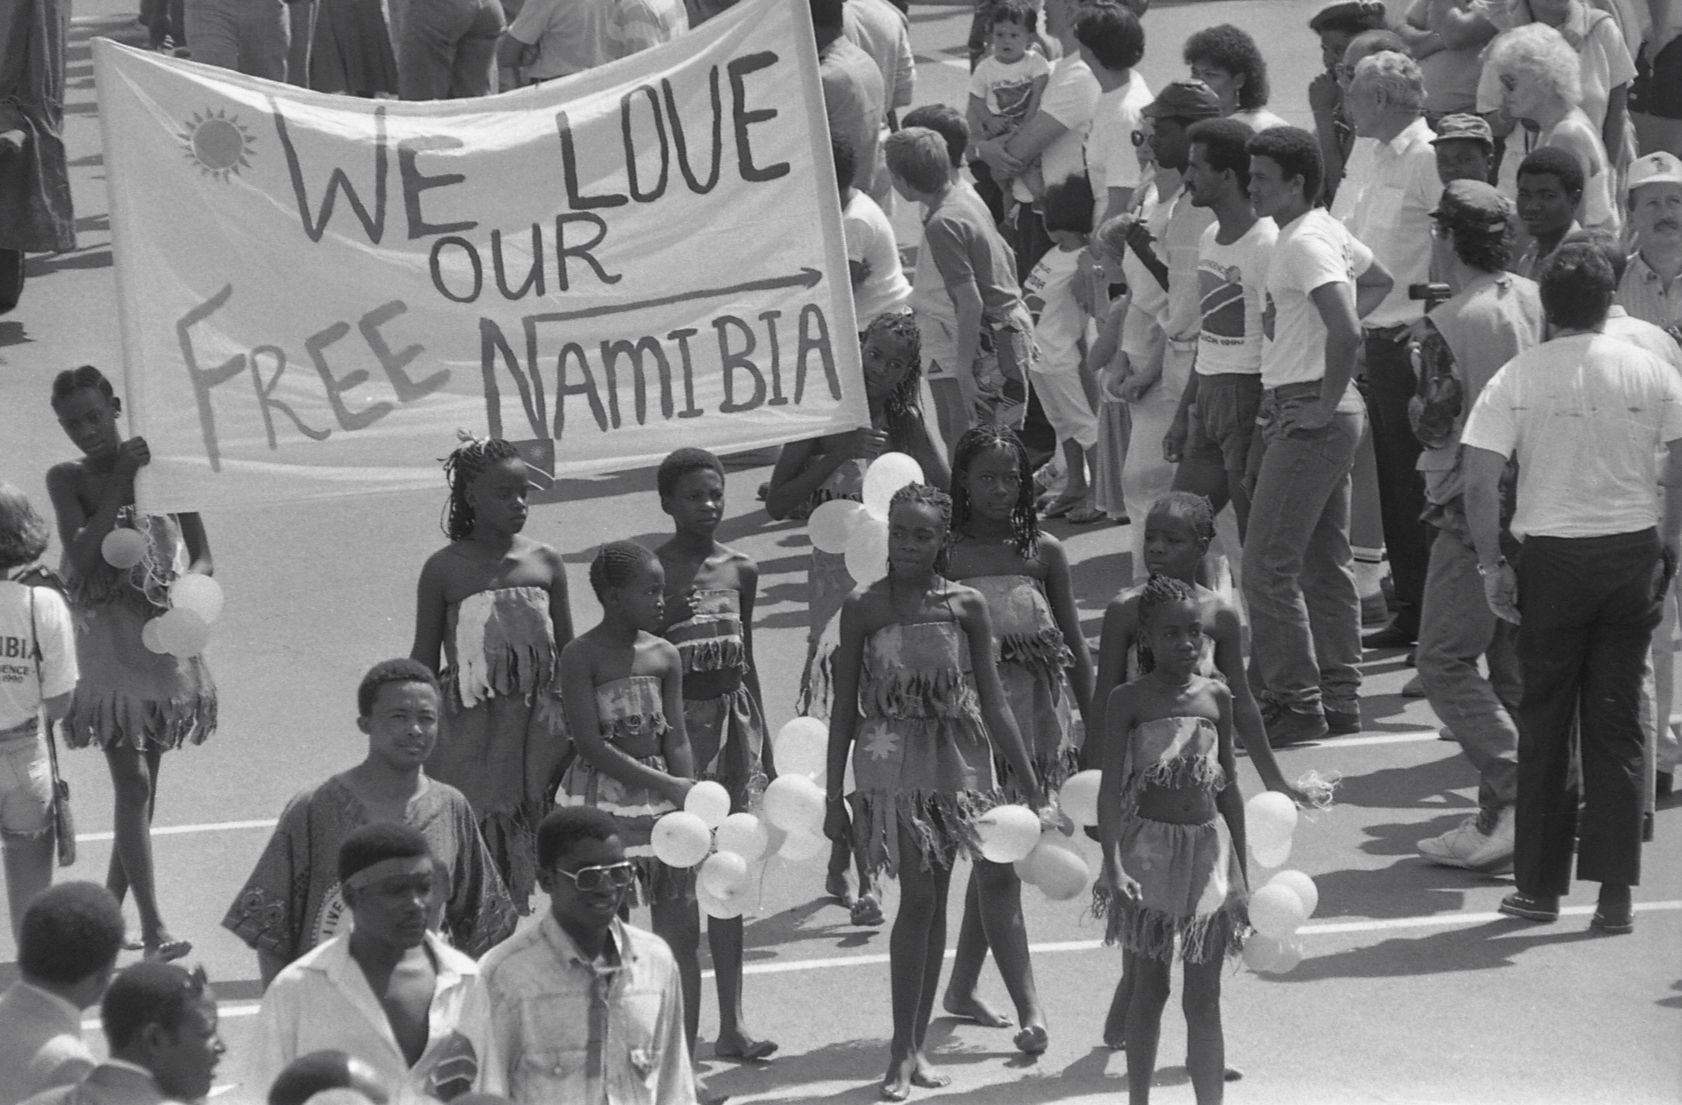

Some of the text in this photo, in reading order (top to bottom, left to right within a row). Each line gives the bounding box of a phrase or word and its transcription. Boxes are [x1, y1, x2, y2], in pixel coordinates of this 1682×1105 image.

[265, 50, 791, 244] WE LOVE
[429, 211, 623, 303] OUR
[176, 283, 842, 473] FREE NAMIBIA
